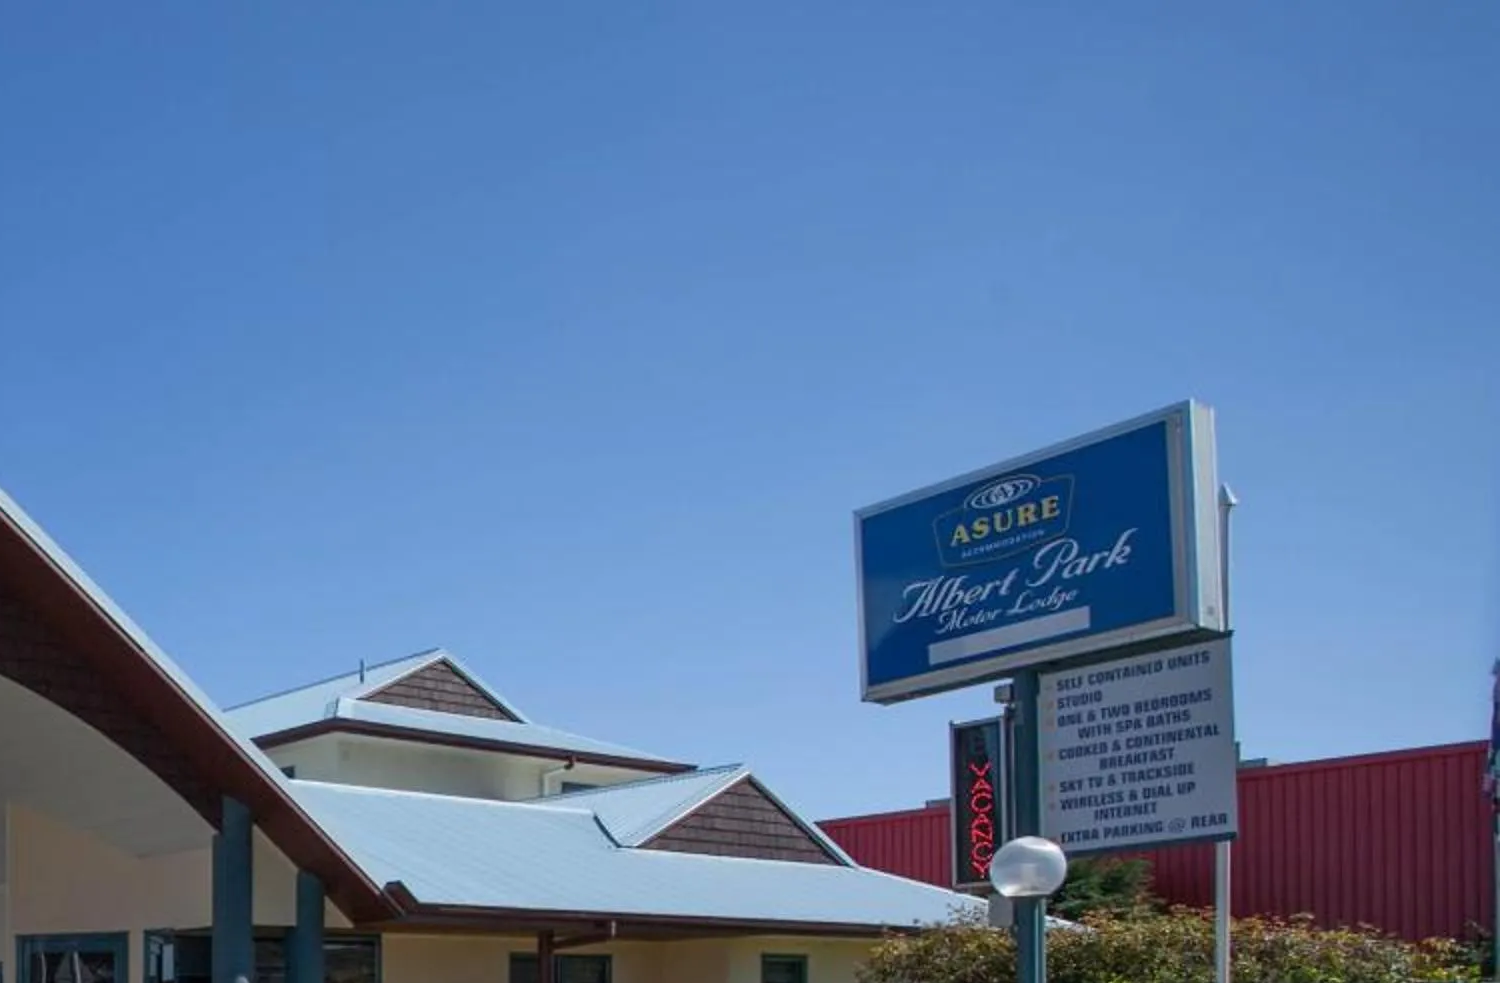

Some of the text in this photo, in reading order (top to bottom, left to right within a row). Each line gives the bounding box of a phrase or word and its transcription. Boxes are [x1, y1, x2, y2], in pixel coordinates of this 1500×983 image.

[951, 495, 1060, 547] ASURE
[893, 528, 1139, 623] Albert Park
[934, 586, 1080, 634] Motor Lodge
[1057, 650, 1210, 691] SELF CONTAINED UNITS
[1057, 691, 1103, 710] STUDIO
[1057, 688, 1213, 728] ONE & TWO BEDROOMS
[1078, 709, 1191, 739] WITH SPA BATHS
[1059, 723, 1220, 760] COOKED & CONTINENTAL
[1099, 747, 1175, 771] BREAKFAST
[1059, 762, 1195, 793] SKY TV & TRACKSIDE
[1060, 782, 1196, 811] WIRELESS & DIAL UP
[1094, 802, 1157, 821] INTERNET
[968, 760, 994, 878] VACANCY
[1061, 829, 1100, 844] EXTRA
[1104, 821, 1163, 839] PARKING
[1191, 813, 1228, 829] REAR
